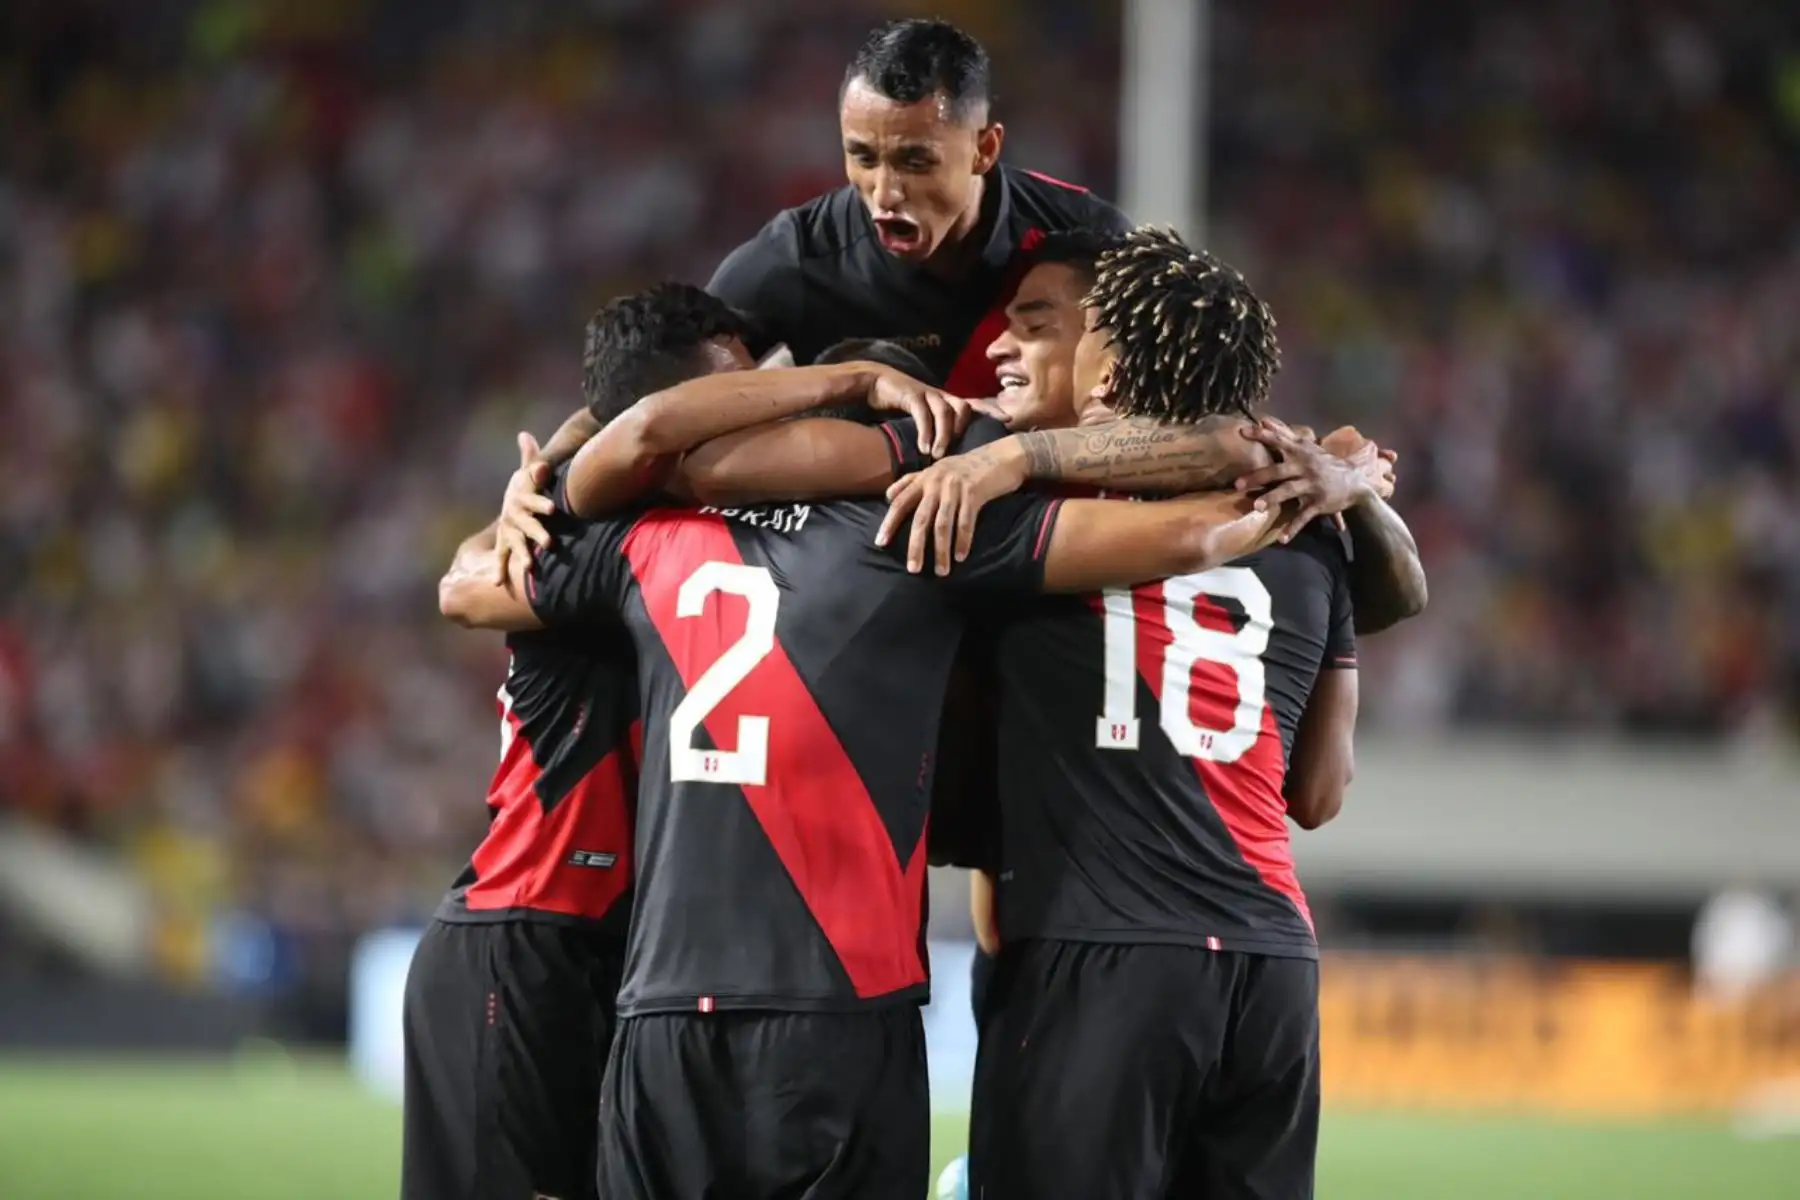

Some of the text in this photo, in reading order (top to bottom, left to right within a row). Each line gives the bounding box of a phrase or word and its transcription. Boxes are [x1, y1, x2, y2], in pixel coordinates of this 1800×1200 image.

[1086, 430, 1176, 454] Familia
[669, 560, 780, 786] 2
[1096, 566, 1275, 764] 18
